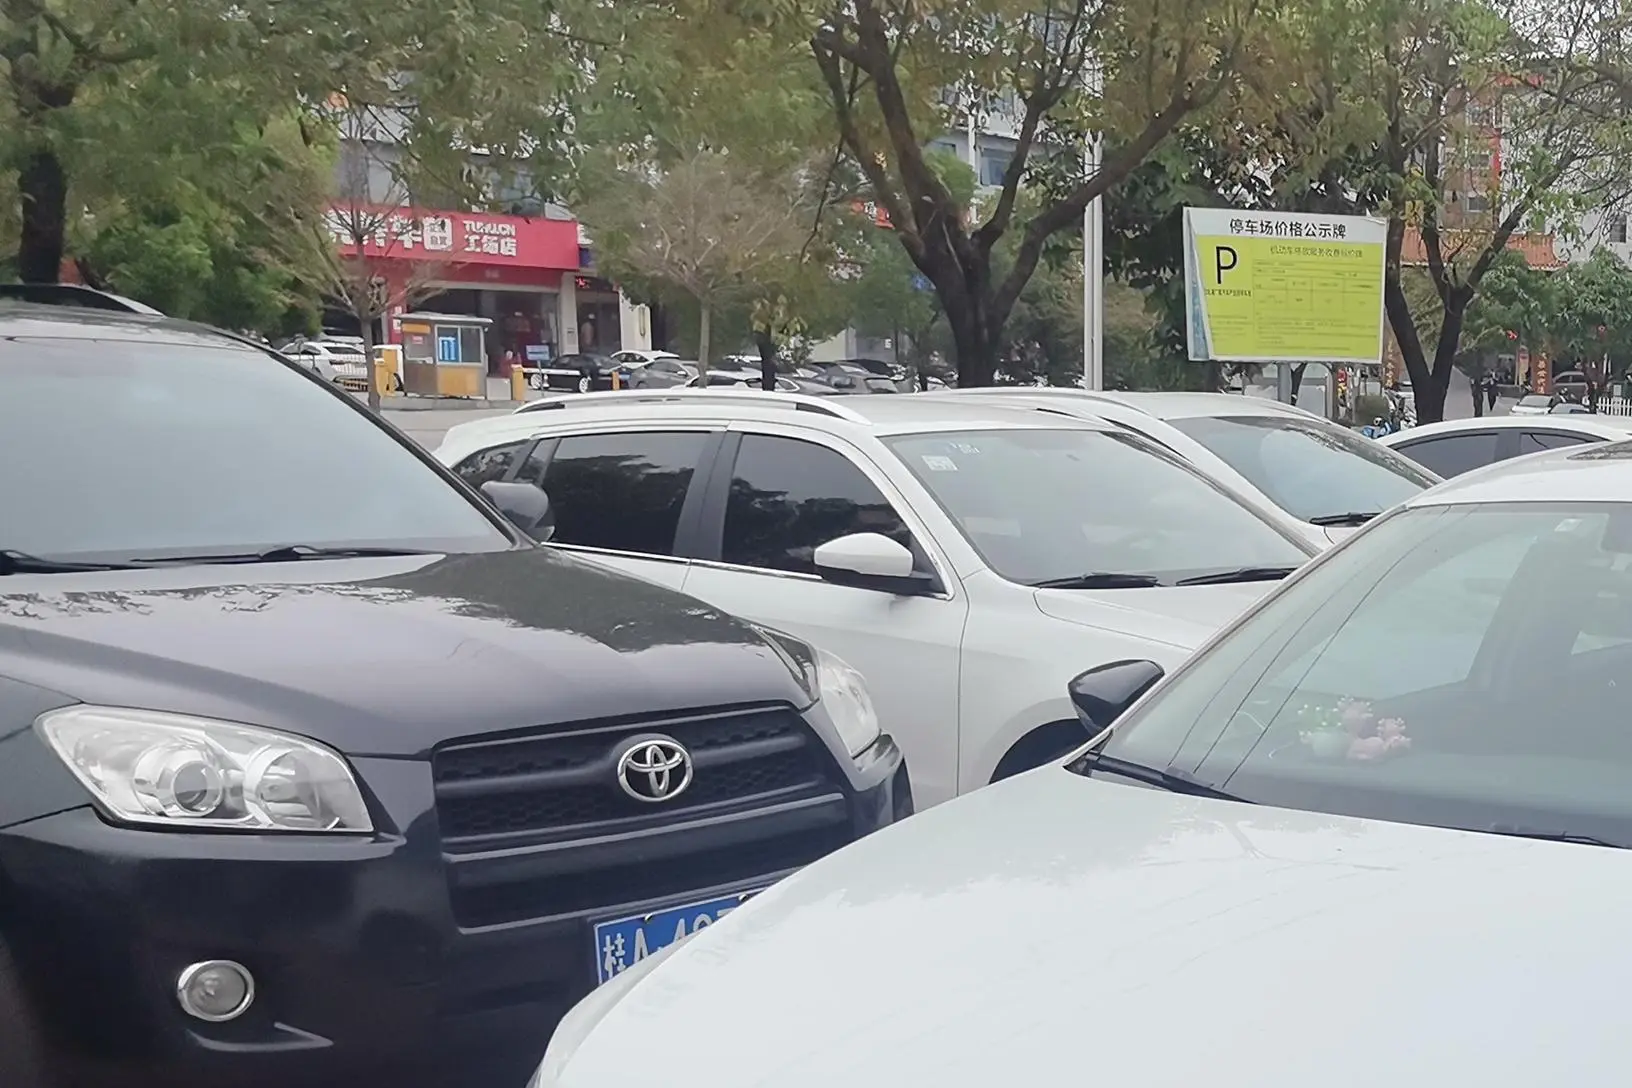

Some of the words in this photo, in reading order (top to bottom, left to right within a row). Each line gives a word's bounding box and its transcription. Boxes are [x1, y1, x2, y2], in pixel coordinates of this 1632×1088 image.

[1229, 218, 1347, 239] 停车场价格公示牌
[1215, 245, 1238, 285] P
